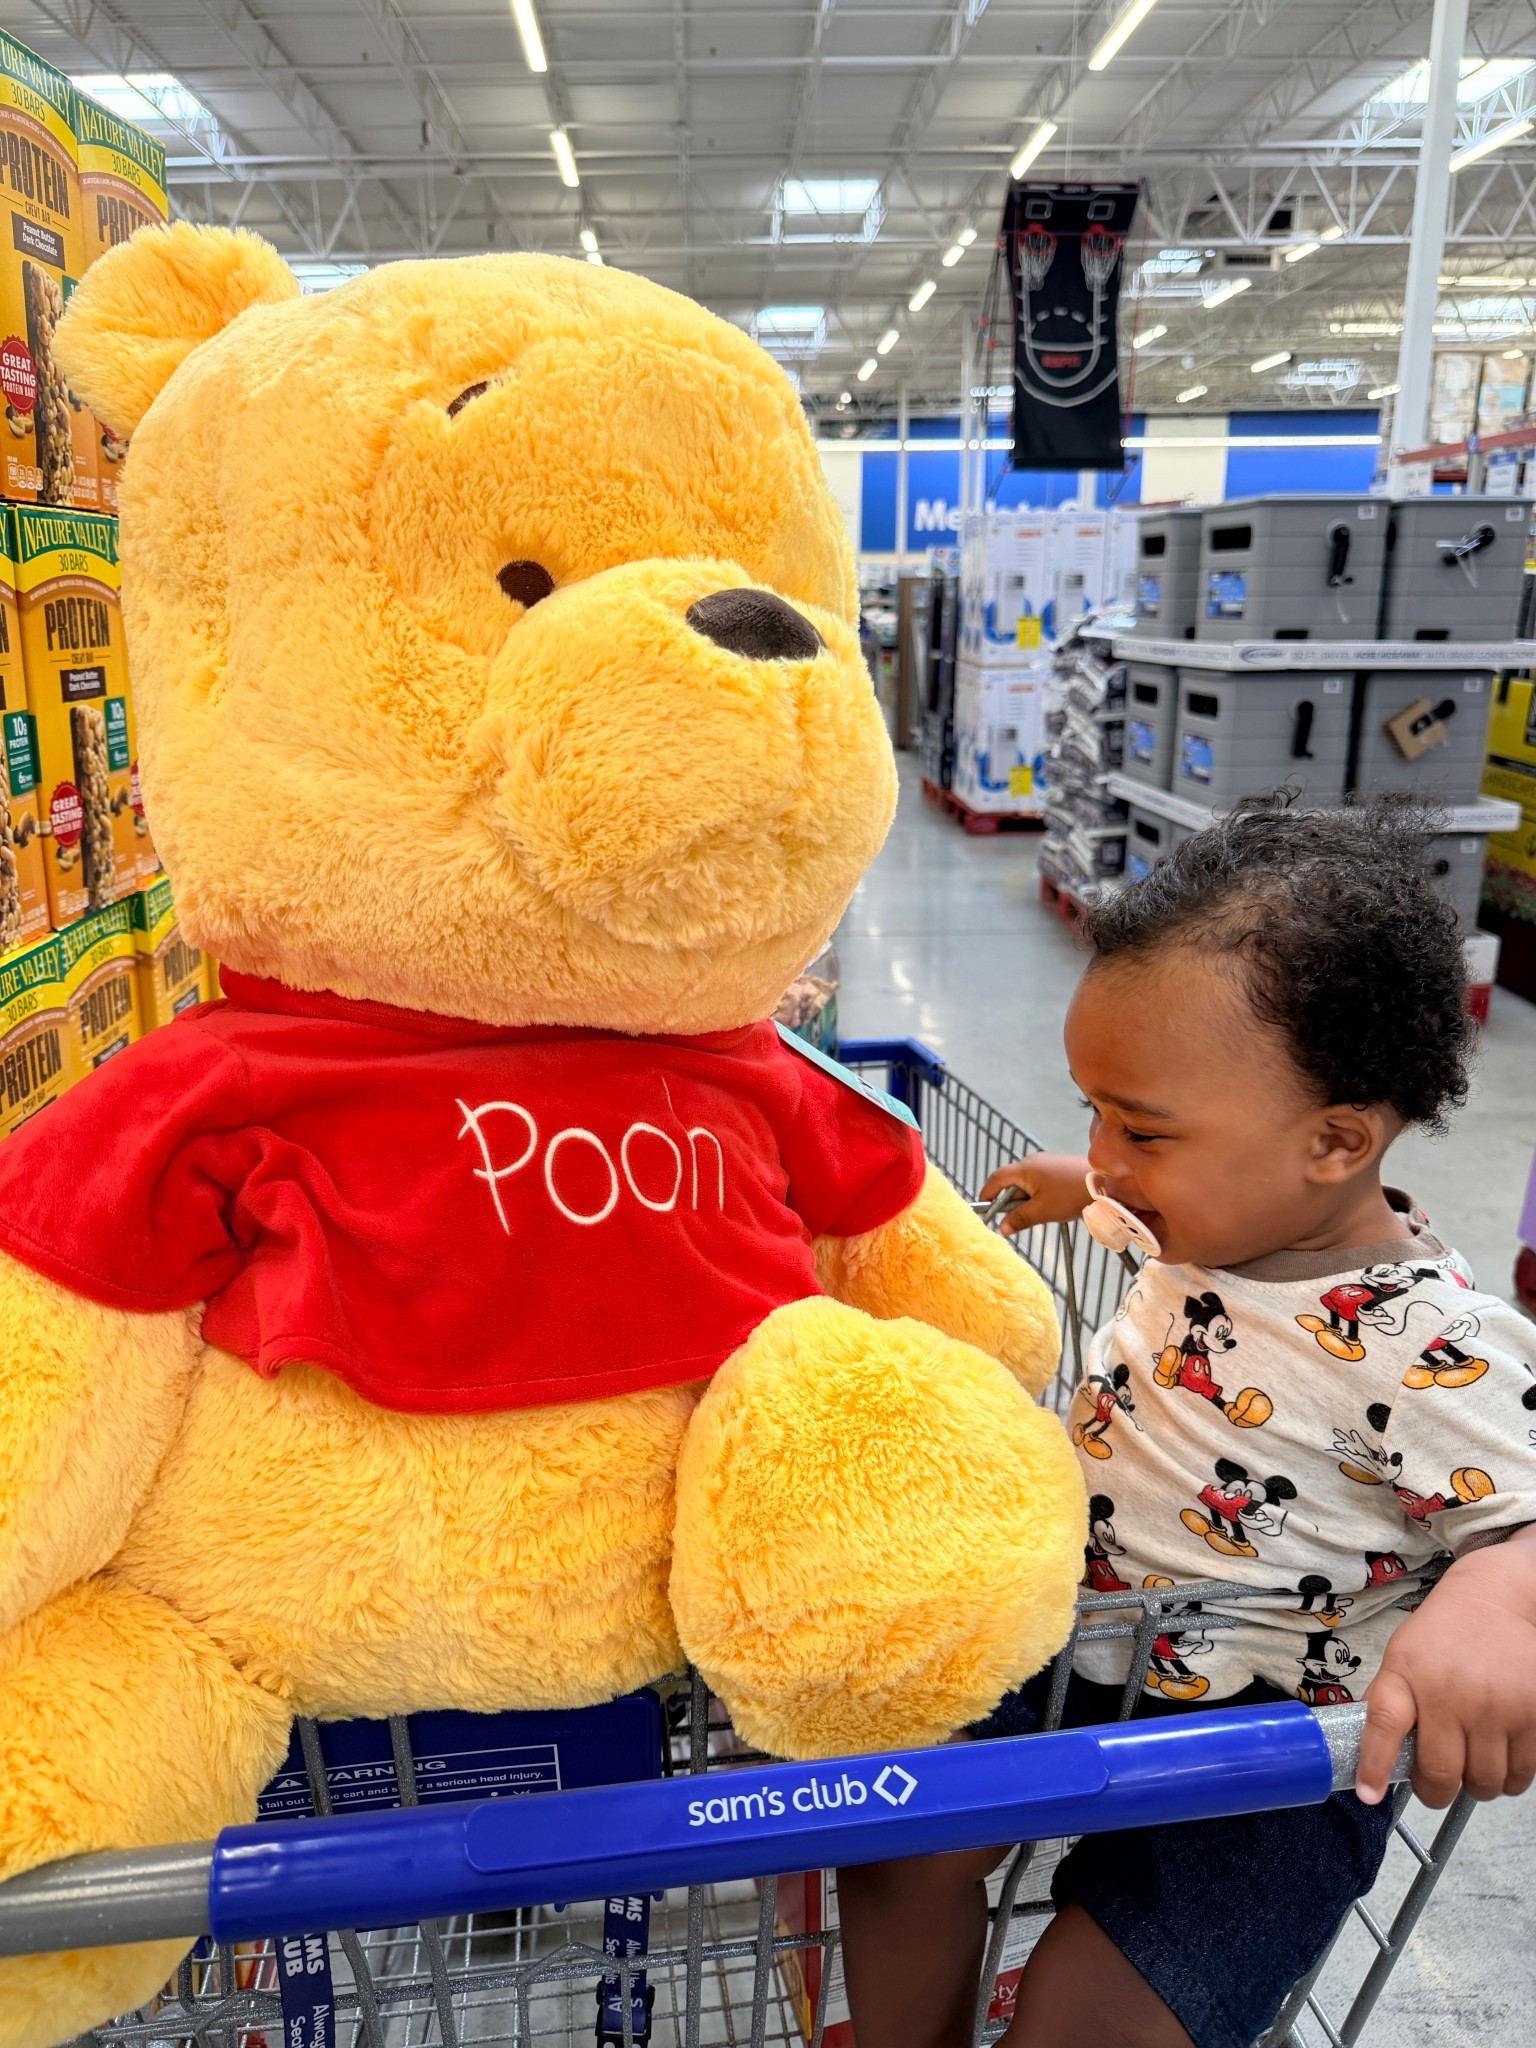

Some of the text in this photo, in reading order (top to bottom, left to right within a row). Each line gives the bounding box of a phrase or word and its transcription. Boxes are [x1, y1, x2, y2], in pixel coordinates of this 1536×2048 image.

[0, 37, 70, 126] URE VALLEY
[11, 83, 45, 121] 30 BARS
[79, 100, 127, 151] NATURE
[126, 134, 164, 187] VALLEY
[112, 154, 141, 185] 30 BARS
[22, 233, 35, 247] Dark
[35, 239, 58, 257] Chocolate
[23, 222, 56, 245] Peanut Butter
[0, 366, 36, 387] TASTING
[3, 352, 31, 371] GREAT
[3, 380, 24, 395] PROTEIN
[23, 516, 73, 558] NATURE
[72, 521, 110, 561] VALLEY
[58, 553, 88, 572] 30 BARS
[44, 596, 110, 652] PROTEIN
[9, 737, 29, 750] PROTEIN
[13, 716, 28, 737] 10g
[50, 806, 83, 826] TASTING
[53, 795, 78, 812] GREAT
[60, 917, 101, 972] NATURE
[100, 902, 131, 935] VALLEY
[19, 943, 60, 986] VALLEY
[7, 992, 38, 1026] 30 BARS
[80, 974, 132, 1046] PROTEIN
[306, 1760, 447, 1784] ARNNG
[266, 1797, 284, 1809] fall
[286, 1797, 305, 1807] out
[343, 1789, 365, 1800] cart
[367, 1787, 389, 1796] and
[436, 1777, 477, 1788] serious
[480, 1773, 507, 1783] head
[509, 1770, 544, 1782] injury.
[688, 1773, 868, 1826] sam's club
[283, 1937, 304, 1977] UB
[304, 1933, 325, 1975] MS
